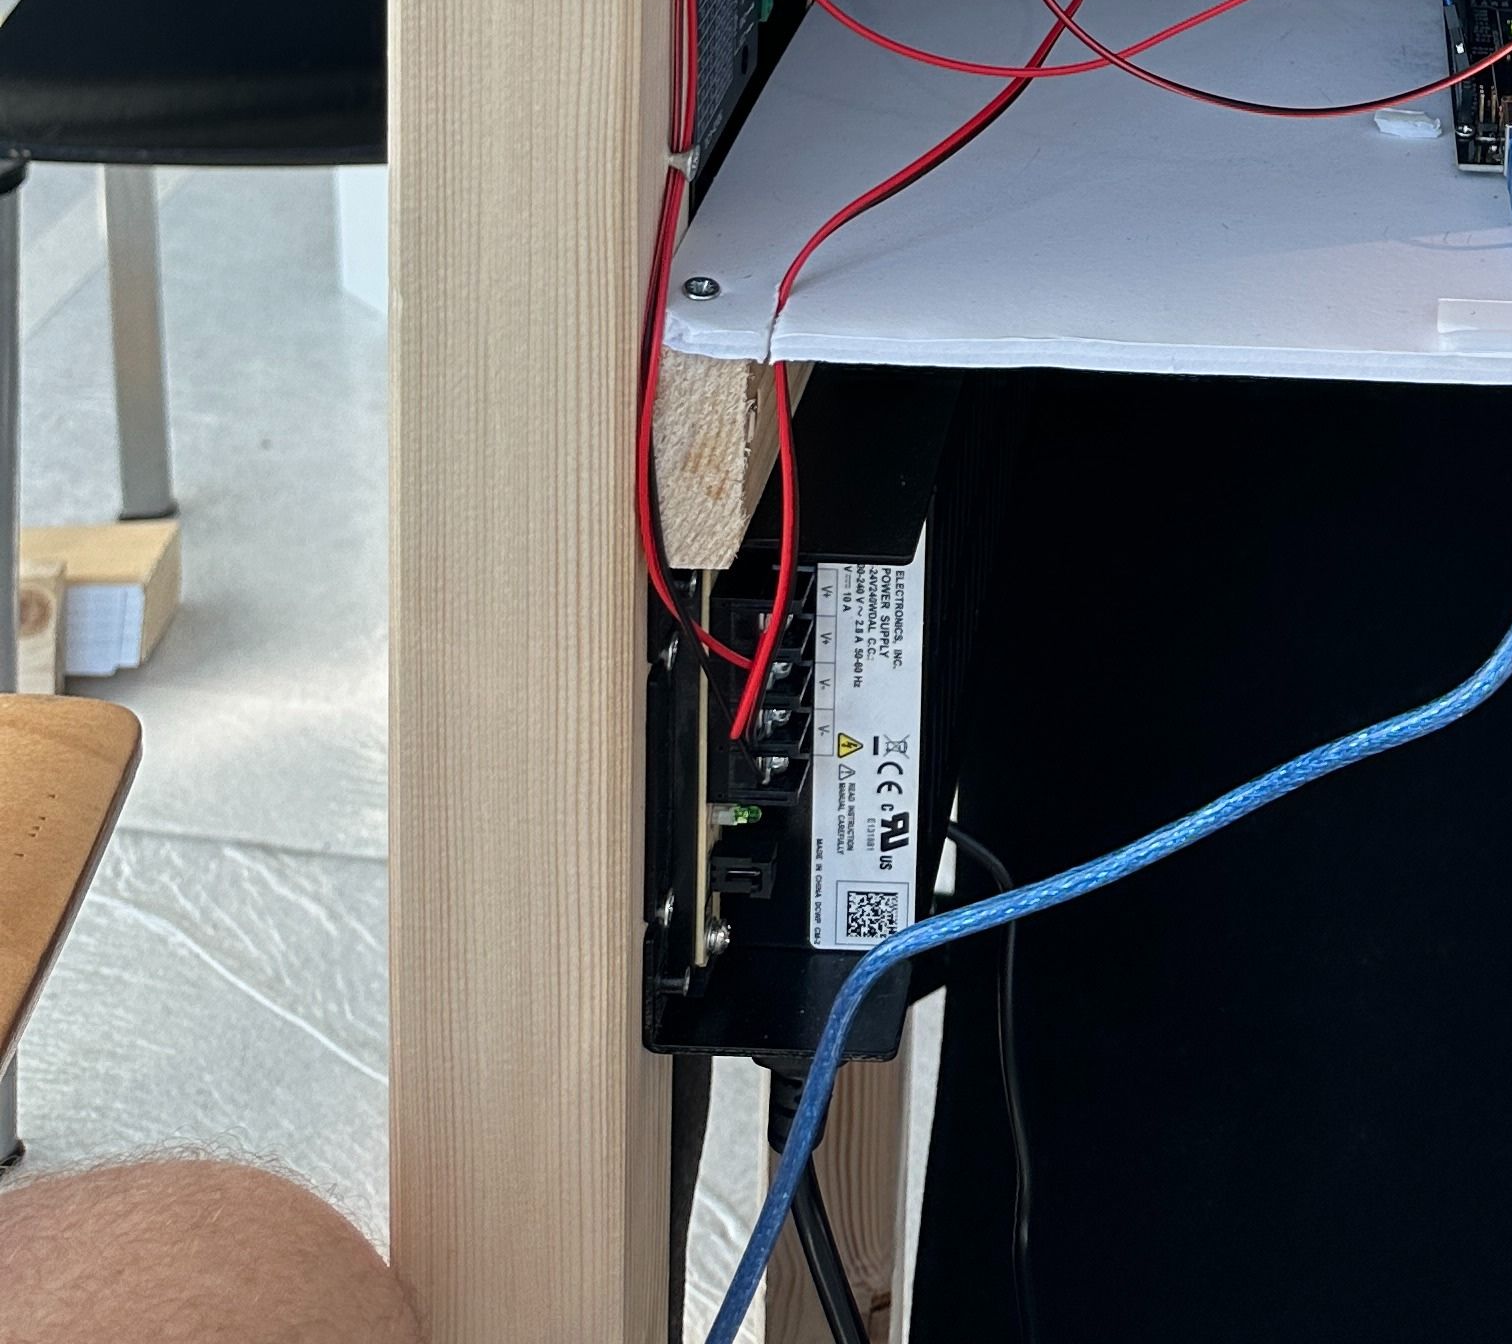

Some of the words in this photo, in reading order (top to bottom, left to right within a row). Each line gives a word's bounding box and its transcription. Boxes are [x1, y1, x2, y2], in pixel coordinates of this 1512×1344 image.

[822, 586, 833, 598] V+
[843, 592, 851, 602] 10
[881, 568, 891, 608] POWER
[893, 571, 904, 644] ELECTRONICS,
[821, 633, 832, 645] V+
[880, 615, 890, 658] SUPPLY
[893, 650, 902, 669] INC.
[854, 676, 862, 687] Hz
[837, 815, 845, 854] CAREFULLY
[847, 806, 855, 851] INSTRUCTION
